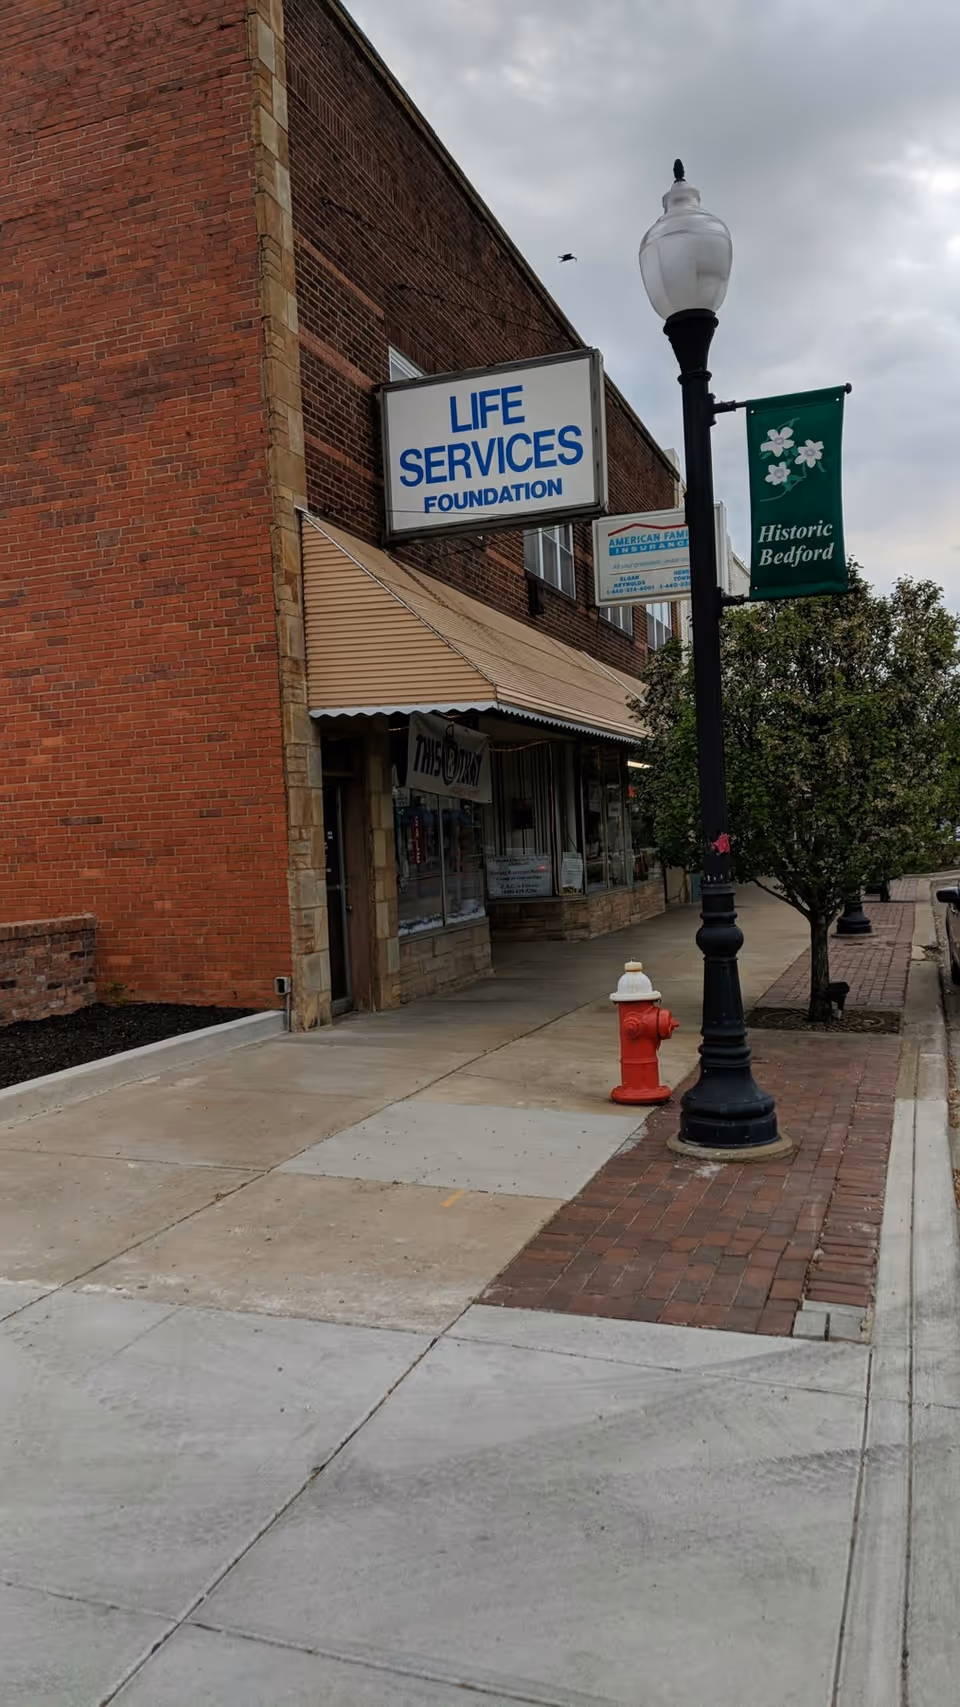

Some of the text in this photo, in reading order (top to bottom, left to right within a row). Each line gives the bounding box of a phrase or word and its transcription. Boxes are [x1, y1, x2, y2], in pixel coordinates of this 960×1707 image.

[449, 385, 525, 433] LIFE
[399, 425, 584, 487] SERVICES
[424, 478, 563, 513] FOUNDATION
[609, 530, 689, 547] AMERICAN FAMI
[758, 520, 833, 544] Historic
[758, 542, 835, 568] Bedford
[413, 733, 442, 777] THIS
